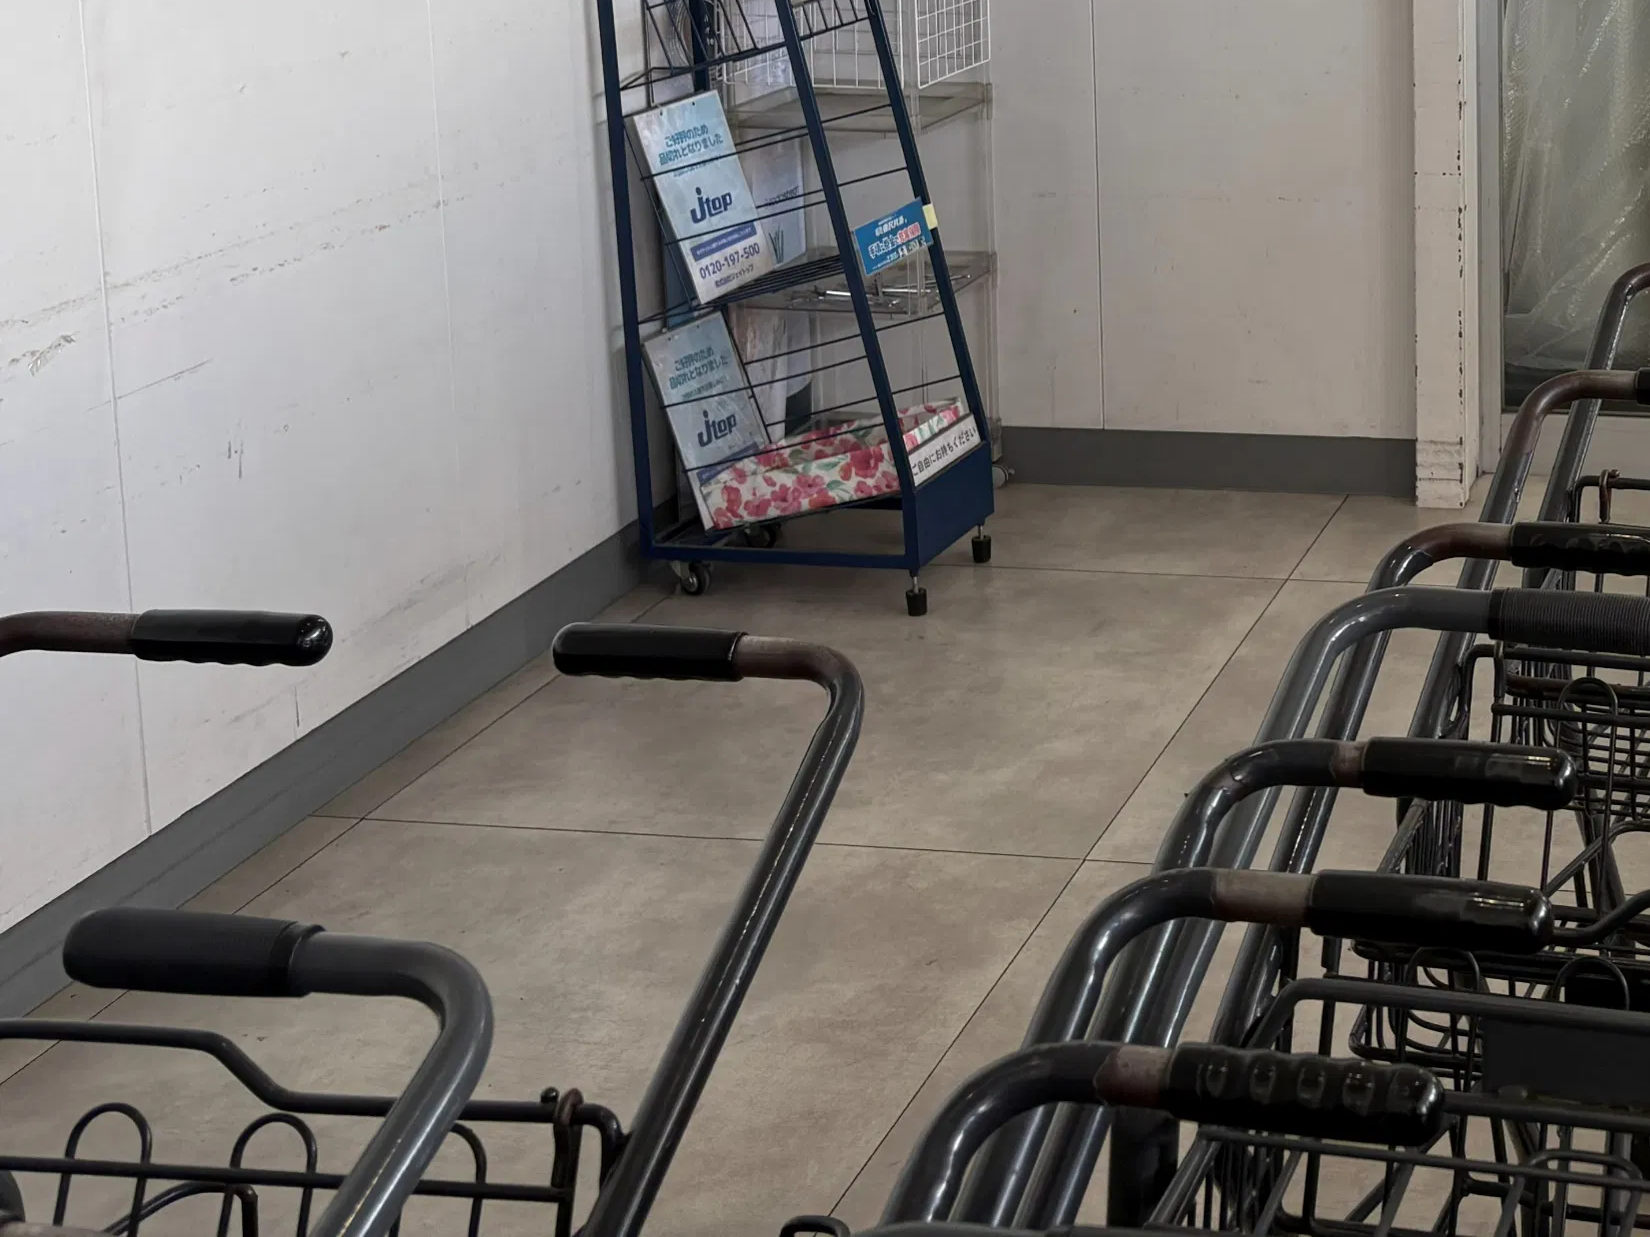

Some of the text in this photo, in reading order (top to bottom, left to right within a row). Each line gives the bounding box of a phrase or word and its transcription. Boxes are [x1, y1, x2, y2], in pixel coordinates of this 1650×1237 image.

[699, 242, 761, 280] 0120-197-500
[911, 426, 977, 477] ご自由にお持ちください
